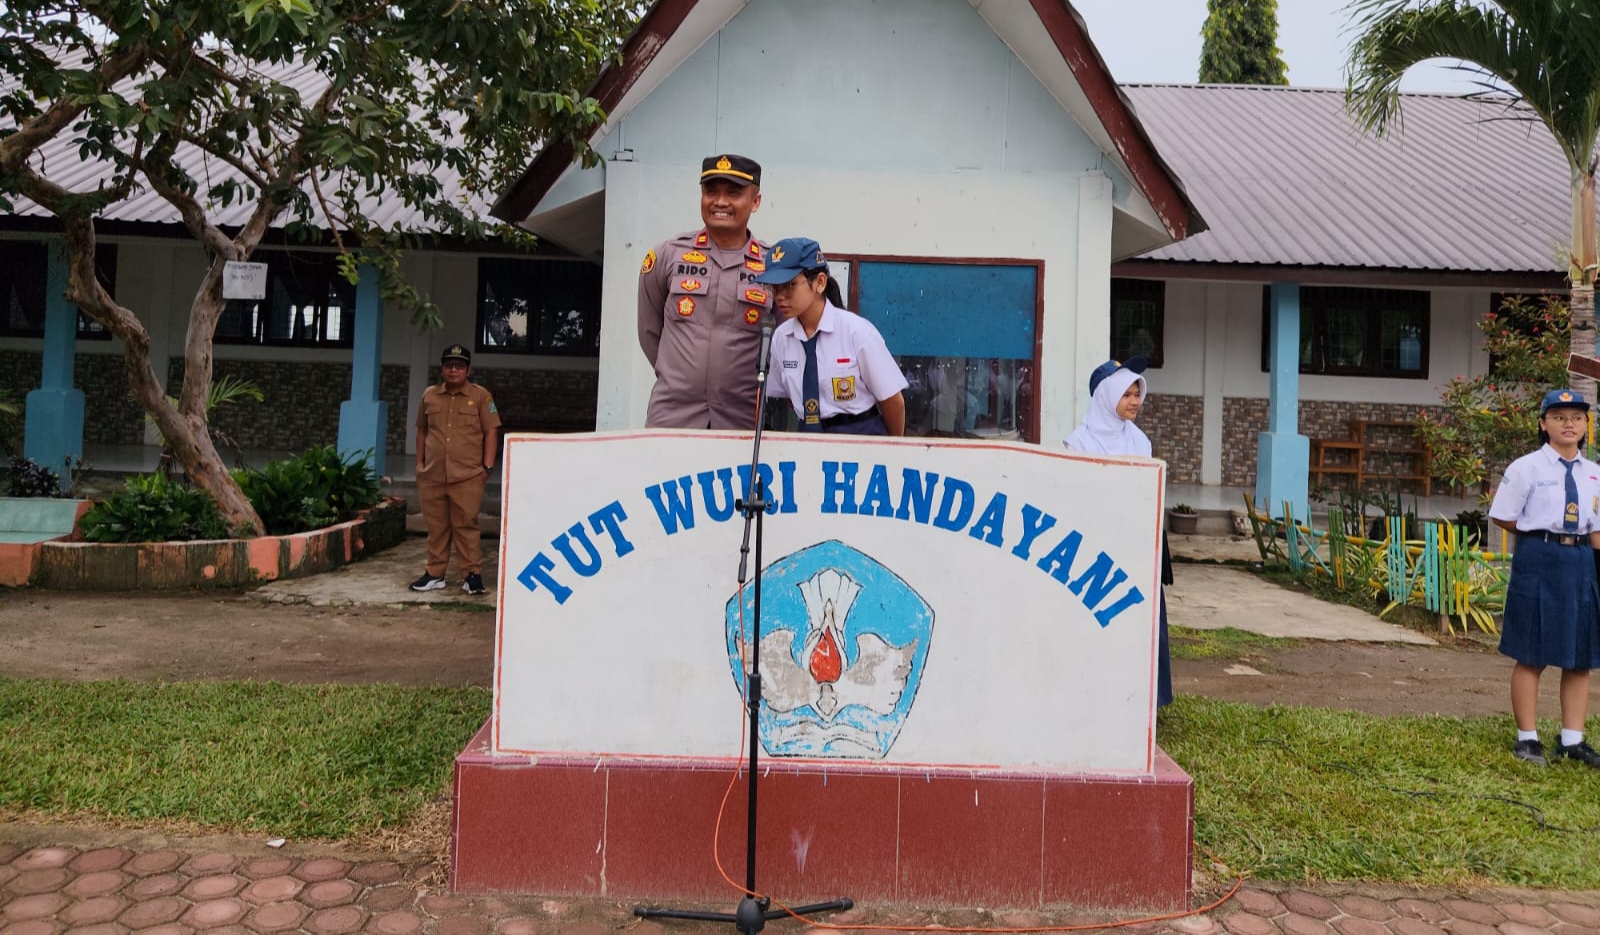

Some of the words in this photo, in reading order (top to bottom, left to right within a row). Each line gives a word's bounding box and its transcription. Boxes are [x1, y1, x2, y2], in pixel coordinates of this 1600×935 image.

[677, 264, 708, 276] RIDO
[517, 500, 634, 604] TUT
[645, 461, 799, 535] WURI
[821, 461, 1144, 628] HANDAYANI
